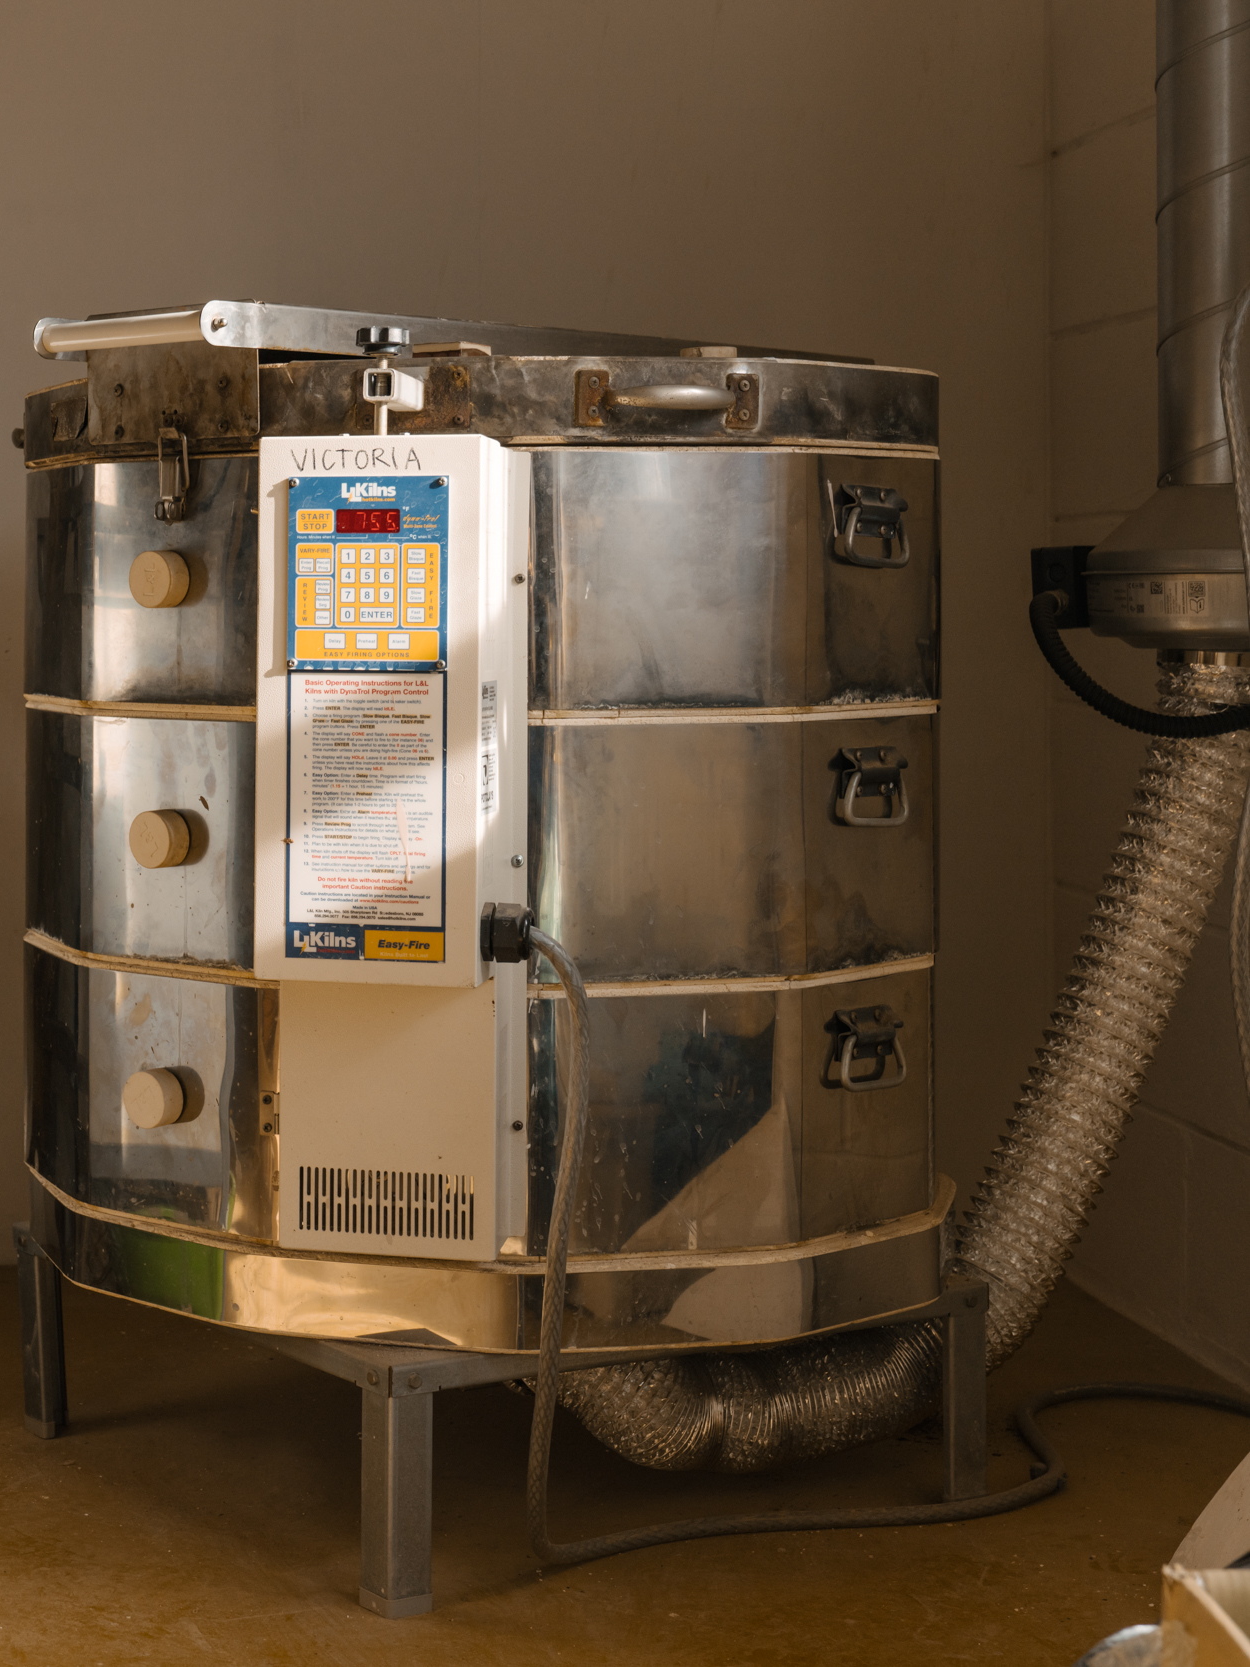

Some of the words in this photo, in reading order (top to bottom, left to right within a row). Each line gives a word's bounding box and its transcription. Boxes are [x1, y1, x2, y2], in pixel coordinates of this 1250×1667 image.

[291, 447, 421, 472] VICTORIA
[346, 552, 350, 560] 1
[365, 552, 370, 560] 2
[384, 552, 390, 560] 3
[345, 572, 351, 580] 4
[365, 572, 370, 580] 5
[384, 572, 390, 580] 6
[345, 591, 351, 599] 7
[364, 591, 370, 599] 8
[384, 591, 390, 600] 9
[345, 611, 350, 619] 0
[378, 939, 430, 950] Easy-Fire
